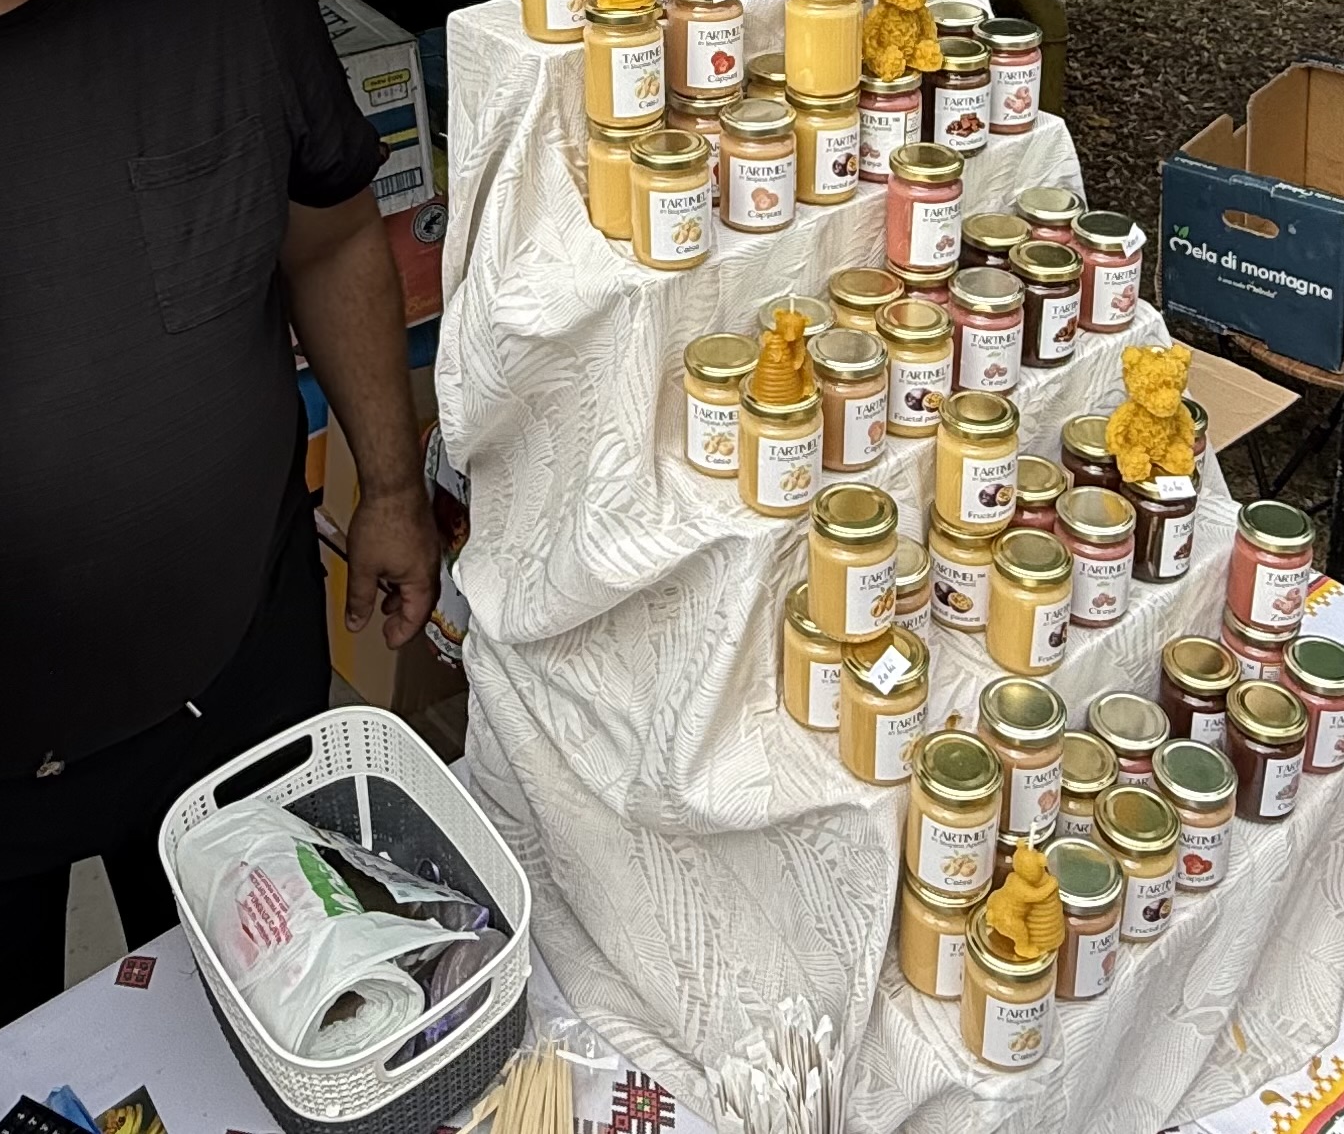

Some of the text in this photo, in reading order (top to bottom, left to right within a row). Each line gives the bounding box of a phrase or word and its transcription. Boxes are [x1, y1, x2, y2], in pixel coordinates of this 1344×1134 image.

[1169, 236, 1217, 264] Mela
[1221, 251, 1237, 271] di
[1241, 260, 1334, 300] montagna
